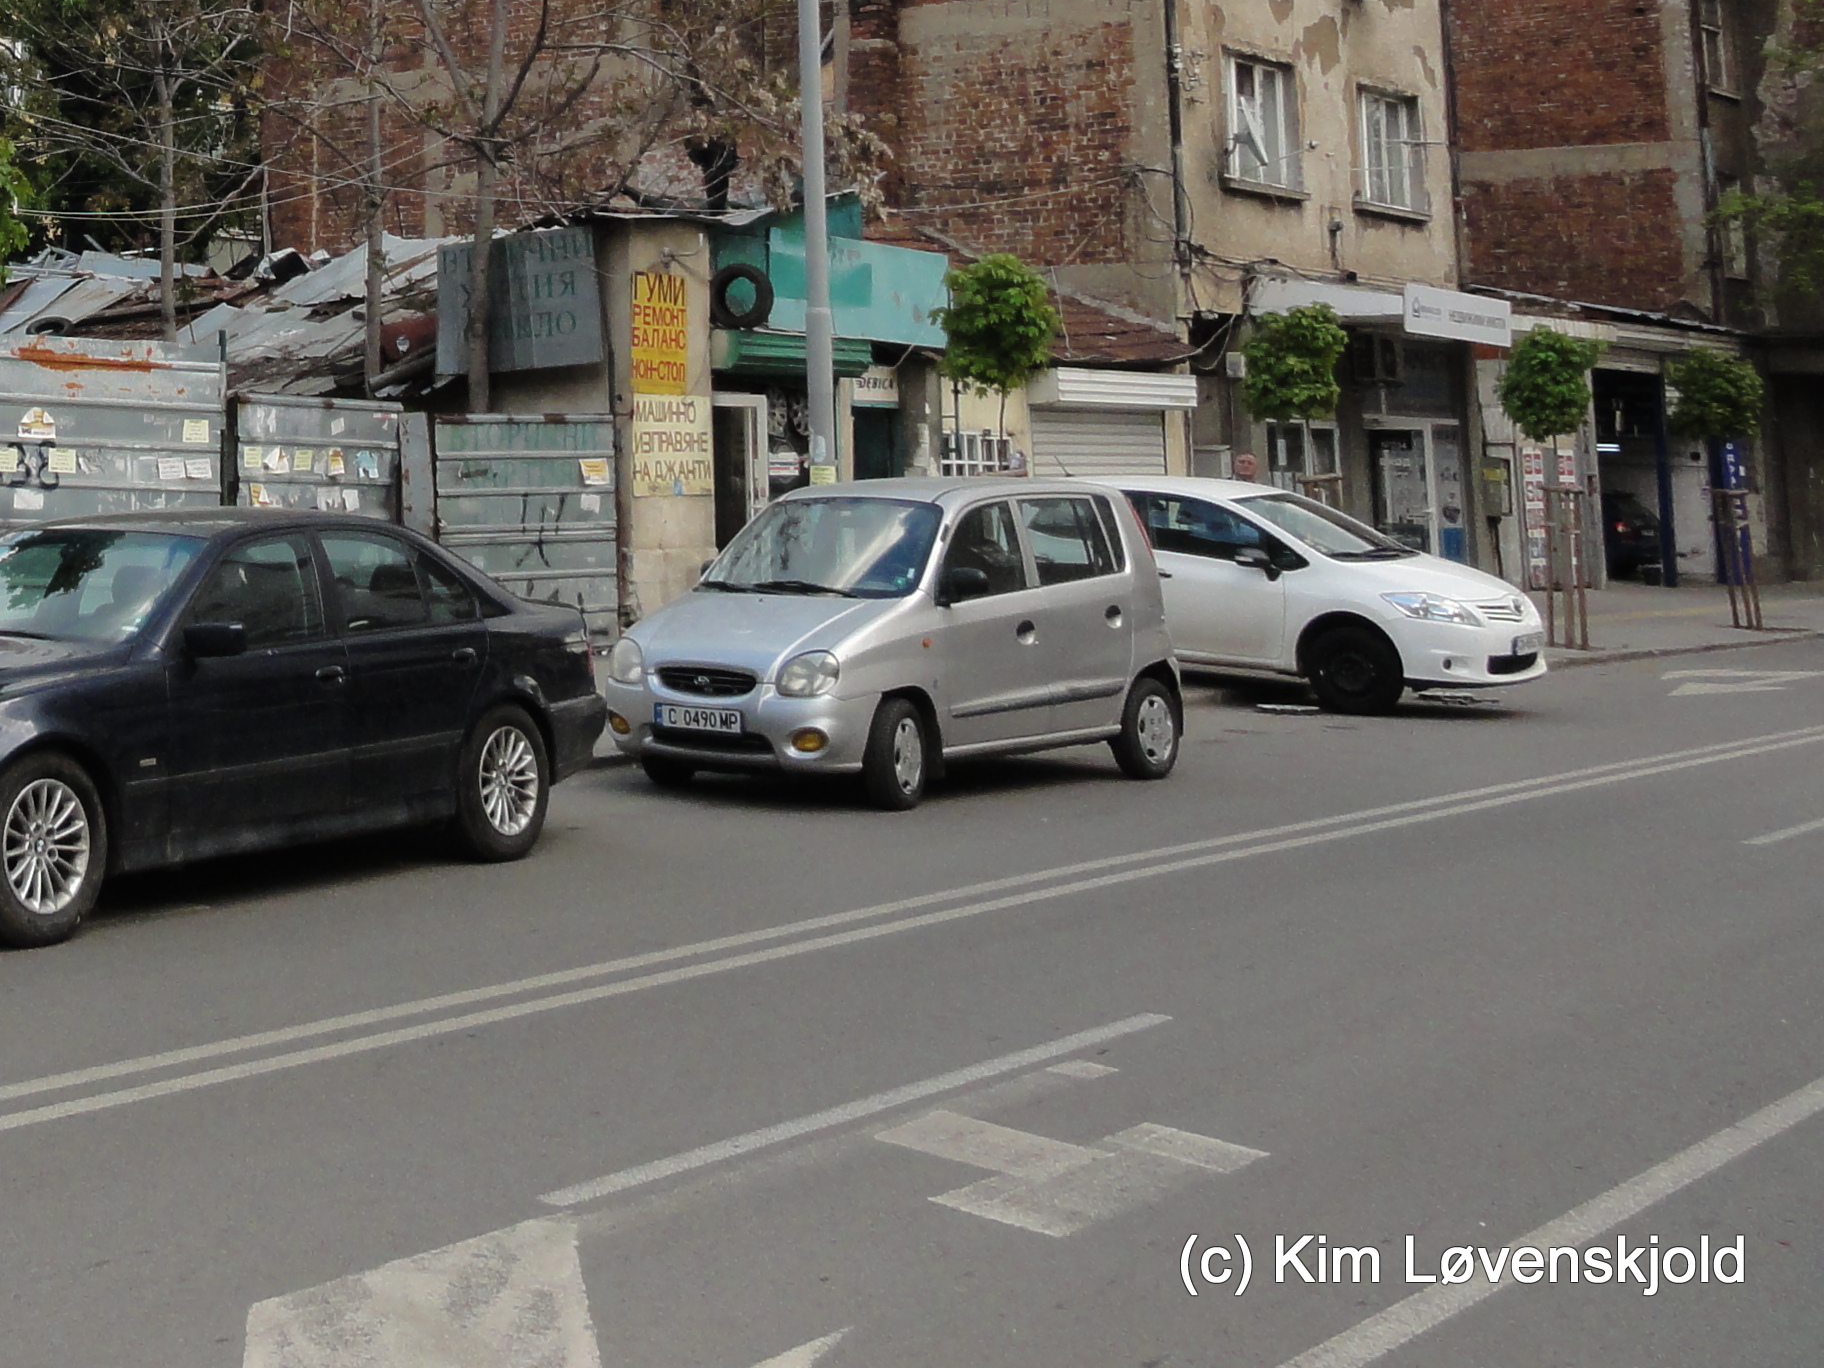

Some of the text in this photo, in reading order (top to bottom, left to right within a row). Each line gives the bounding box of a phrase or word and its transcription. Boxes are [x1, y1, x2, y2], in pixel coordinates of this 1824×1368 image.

[634, 271, 685, 306] ГУМИ
[632, 303, 687, 328] РЕМОНТ
[632, 327, 687, 350] БАЛАНС
[632, 357, 687, 383] НОН-СТОП
[635, 400, 697, 424] МАШИННО
[634, 432, 709, 453] ИЗПРАВЯНЕ
[633, 460, 652, 482] НА
[655, 460, 712, 482] ДЖАНТИ
[668, 708, 738, 730] C 0490 MP
